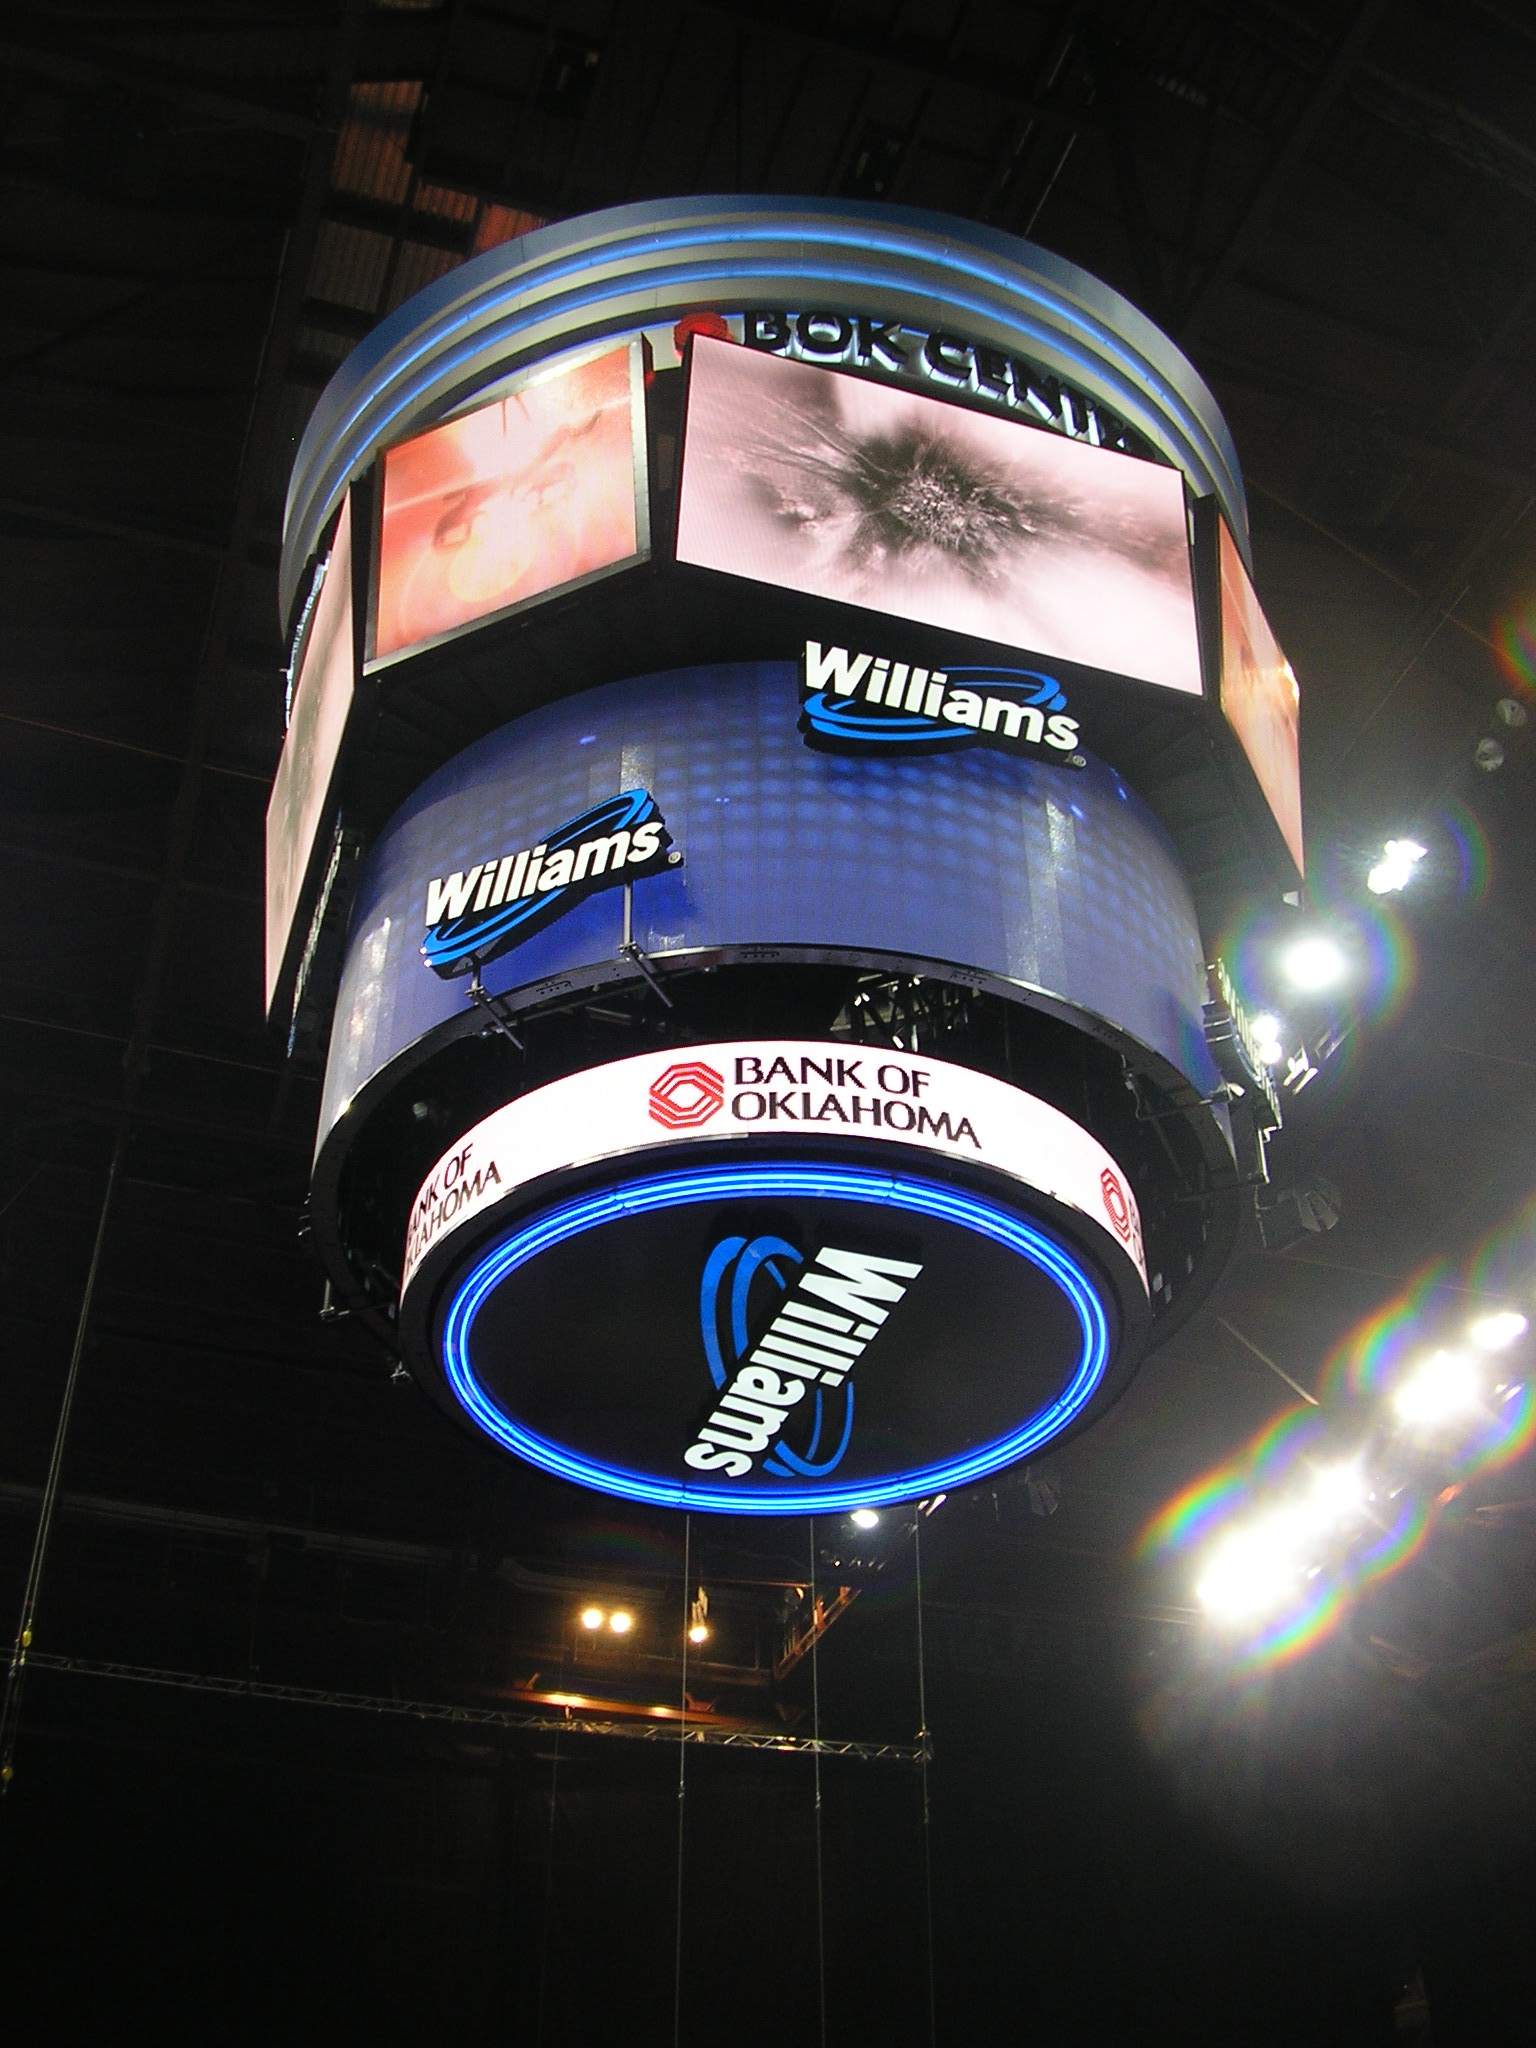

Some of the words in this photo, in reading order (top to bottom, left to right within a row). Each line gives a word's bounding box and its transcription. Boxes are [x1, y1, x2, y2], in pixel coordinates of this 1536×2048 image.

[744, 310, 909, 370] BOK
[805, 640, 1080, 751] Williams
[425, 821, 665, 927] Williams
[734, 1056, 867, 1089] BANK
[877, 1064, 931, 1098] OF
[731, 1091, 982, 1149] OKLAHOMA
[443, 1143, 474, 1190] OF
[684, 1246, 924, 1478] Williams
